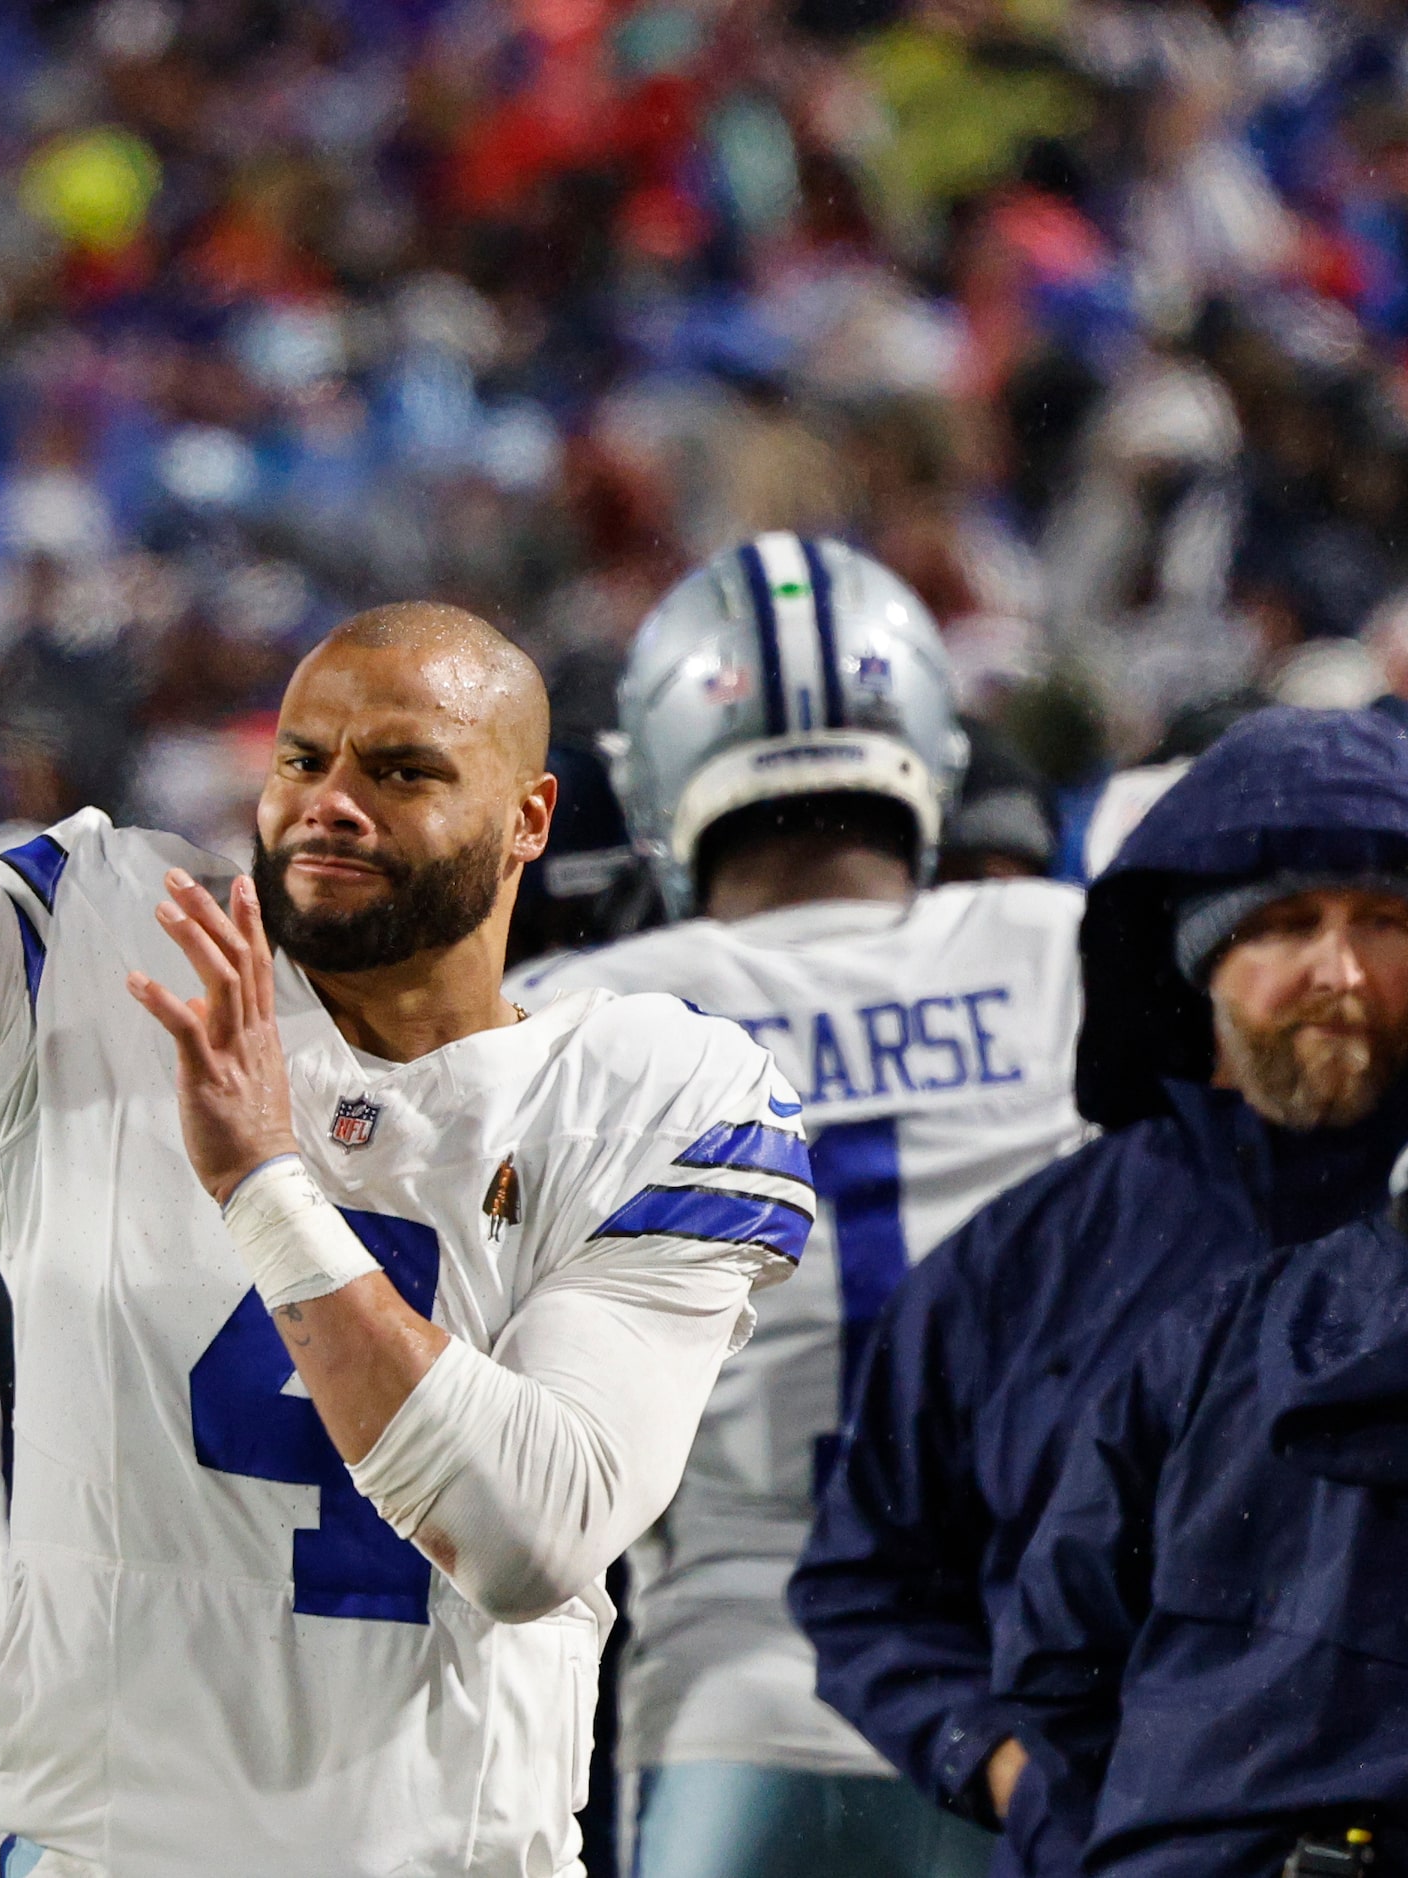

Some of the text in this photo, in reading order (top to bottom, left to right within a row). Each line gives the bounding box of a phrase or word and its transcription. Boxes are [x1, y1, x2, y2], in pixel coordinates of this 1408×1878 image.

[739, 987, 1022, 1103] ARSE
[335, 1117, 368, 1142] NFL
[189, 1206, 440, 1625] 4
